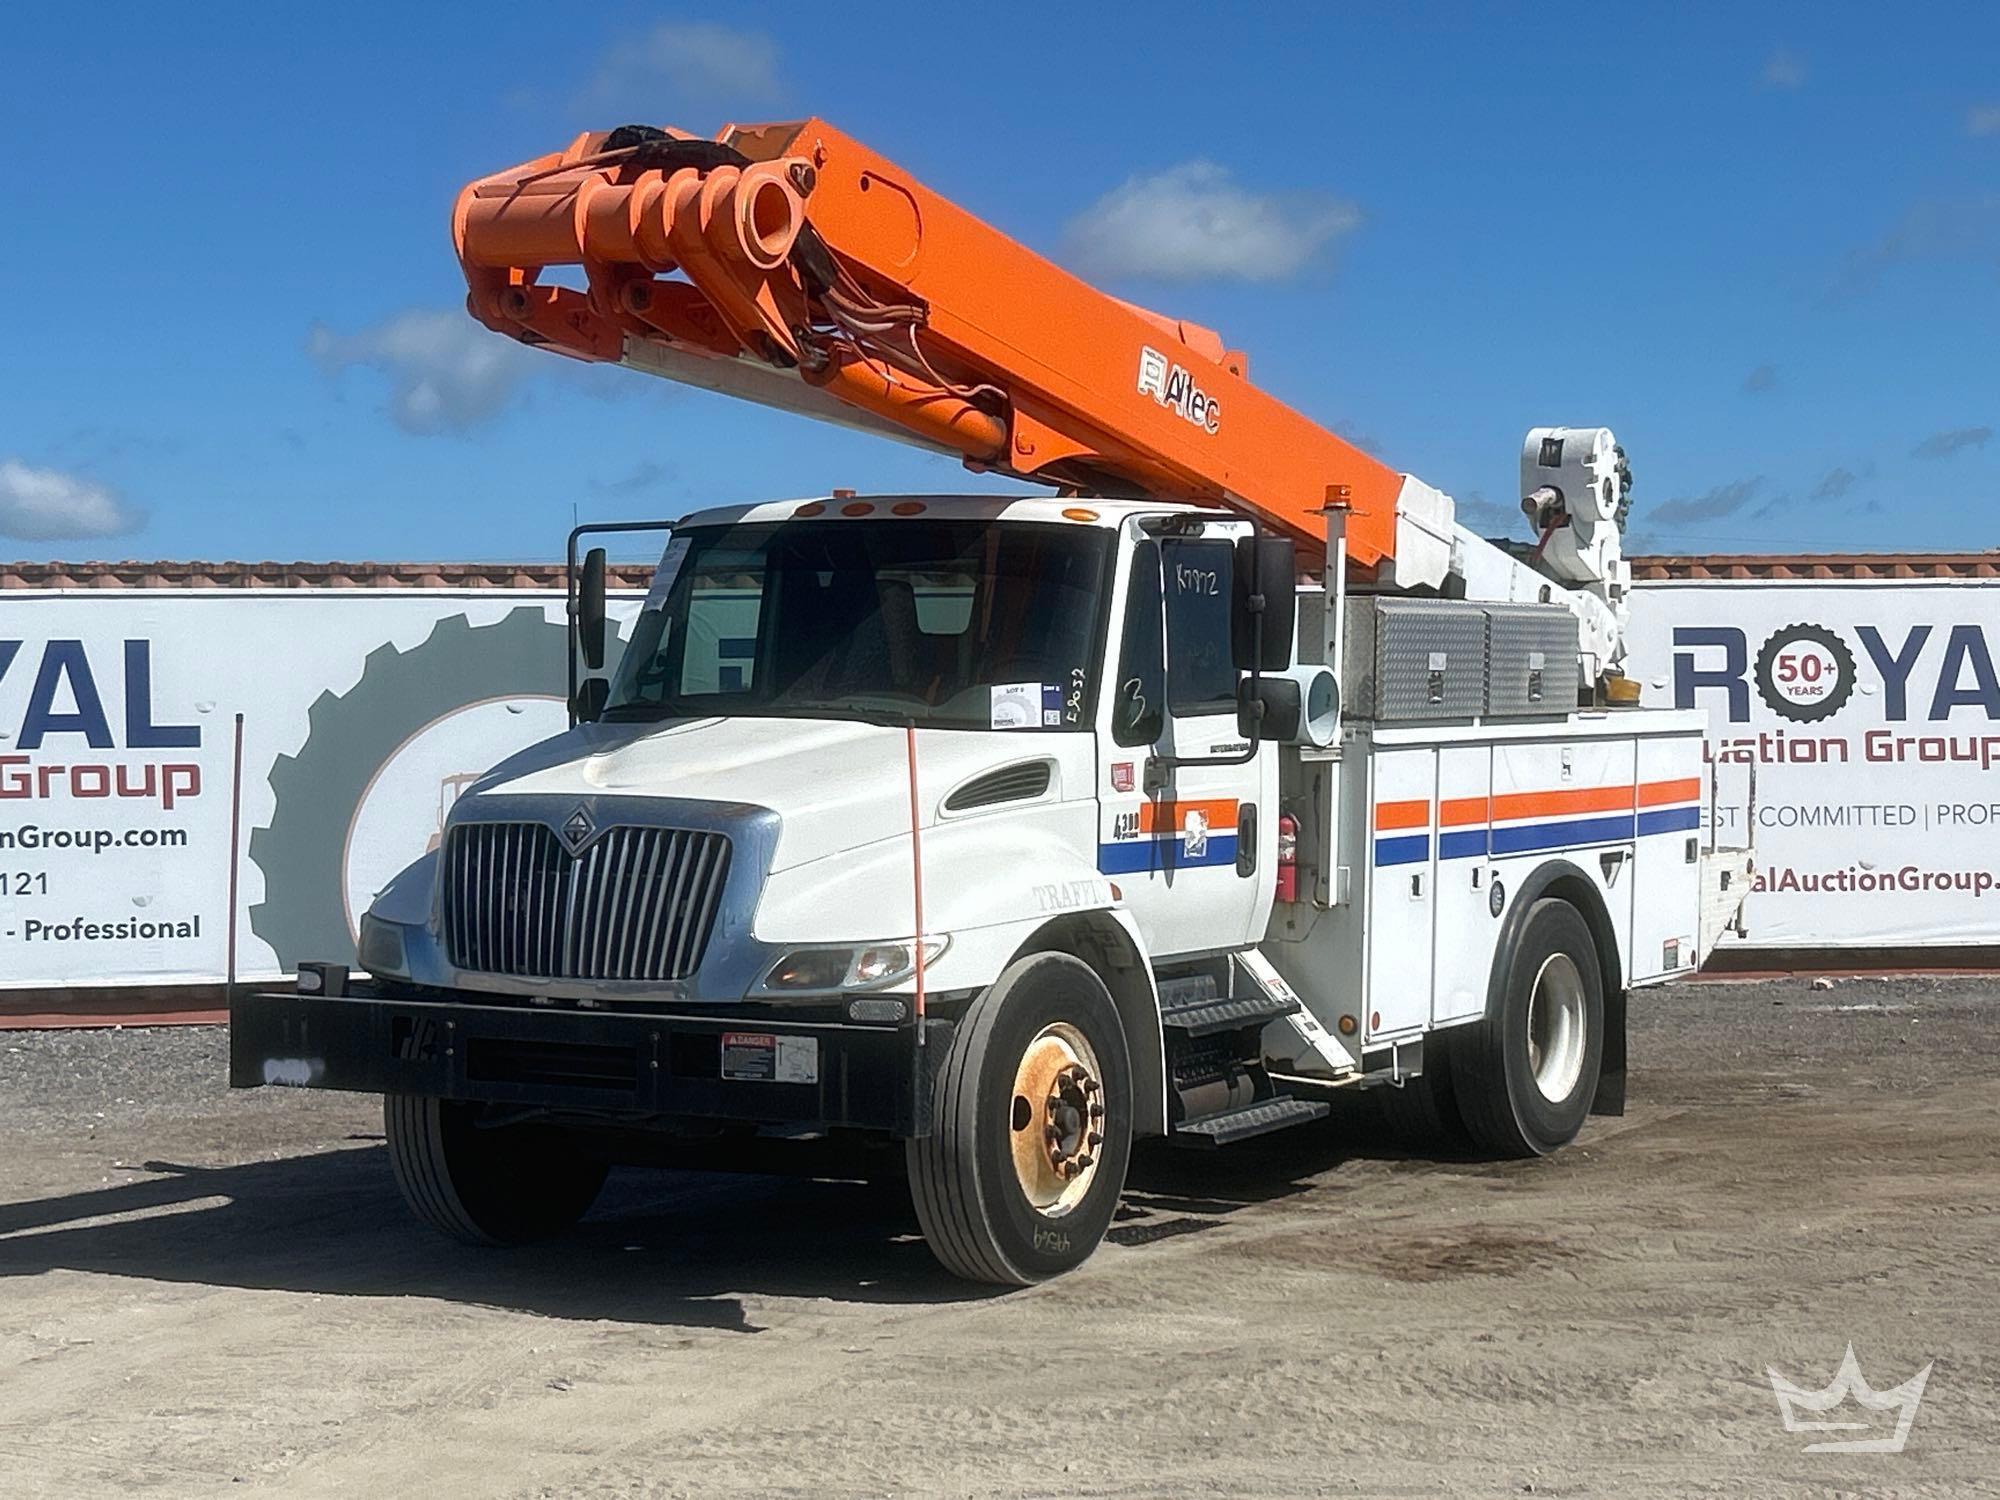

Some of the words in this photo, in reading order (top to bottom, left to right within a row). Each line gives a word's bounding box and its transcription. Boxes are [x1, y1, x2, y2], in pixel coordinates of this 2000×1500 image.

[1163, 368, 1219, 430] Altec
[1777, 654, 1836, 682] 50+
[0, 640, 201, 749] AL
[1786, 686, 1824, 696] YEARS
[0, 755, 201, 810] Group
[1112, 812, 1139, 840] 4300
[1759, 805, 1916, 827] COMMITTED
[0, 825, 187, 854] nGroup.com
[25, 915, 200, 941] Professional
